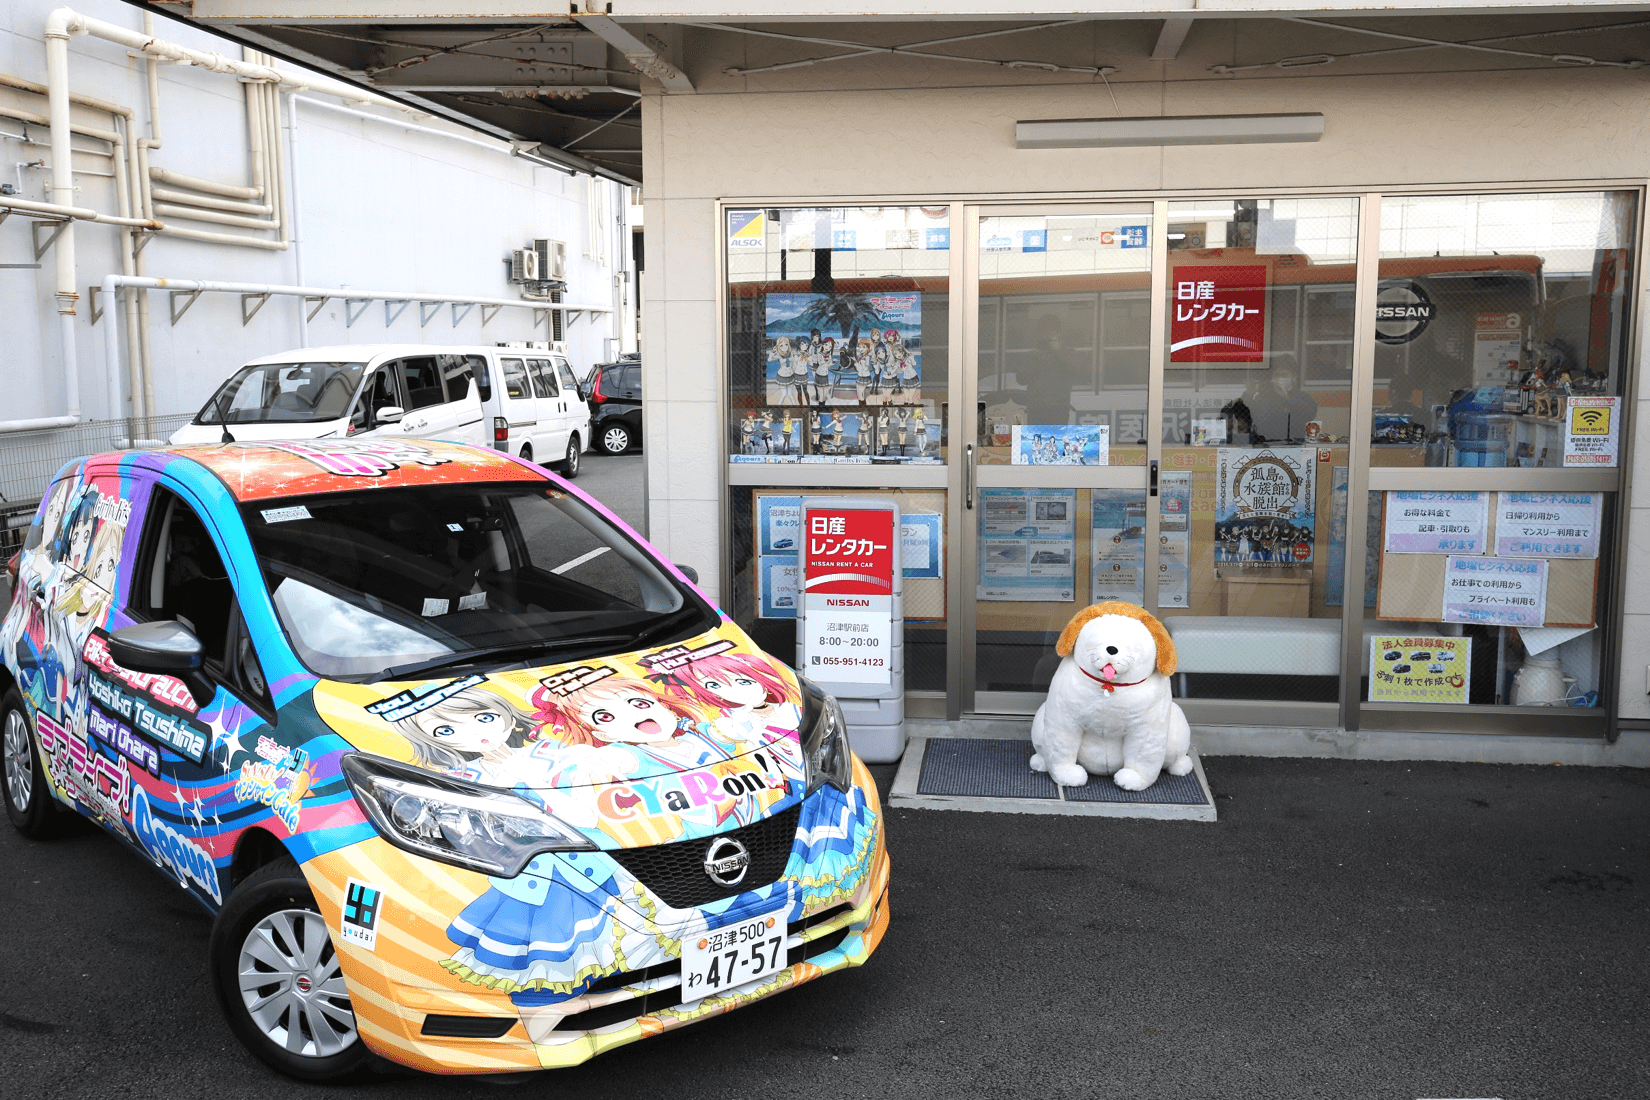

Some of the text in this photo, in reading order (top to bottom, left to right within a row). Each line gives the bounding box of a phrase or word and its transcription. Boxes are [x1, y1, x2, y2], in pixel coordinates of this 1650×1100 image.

[731, 239, 763, 247] ALSOK
[1177, 280, 1215, 300] 日産
[1176, 302, 1260, 322] レンタカー
[1250, 466, 1284, 482] 孤島の
[1252, 496, 1279, 510] 脱出
[1505, 511, 1561, 520] 日帰り利用から
[811, 516, 846, 535] 日産
[1522, 528, 1590, 538] マンスリー利用まで
[811, 538, 888, 556] レンタカー
[1438, 539, 1478, 550] 承ります
[1509, 541, 1583, 554] ご利用できます
[1455, 560, 1539, 574] 地場ビジネス応援
[1451, 579, 1522, 590] お仕事での利用から
[826, 598, 870, 607] NISSAN
[1469, 595, 1536, 606] プライベート利用も
[826, 622, 870, 633] 沼津駅前店
[1382, 637, 1456, 650] 法人会員募集中
[823, 656, 884, 667] 055-951-4123
[134, 701, 205, 759] Tsushima
[117, 727, 158, 770] Ohara
[597, 753, 769, 820] CYaRon!
[133, 785, 222, 906] Aqours
[711, 854, 750, 872] NISSAN
[688, 935, 782, 989] わ 47-57
